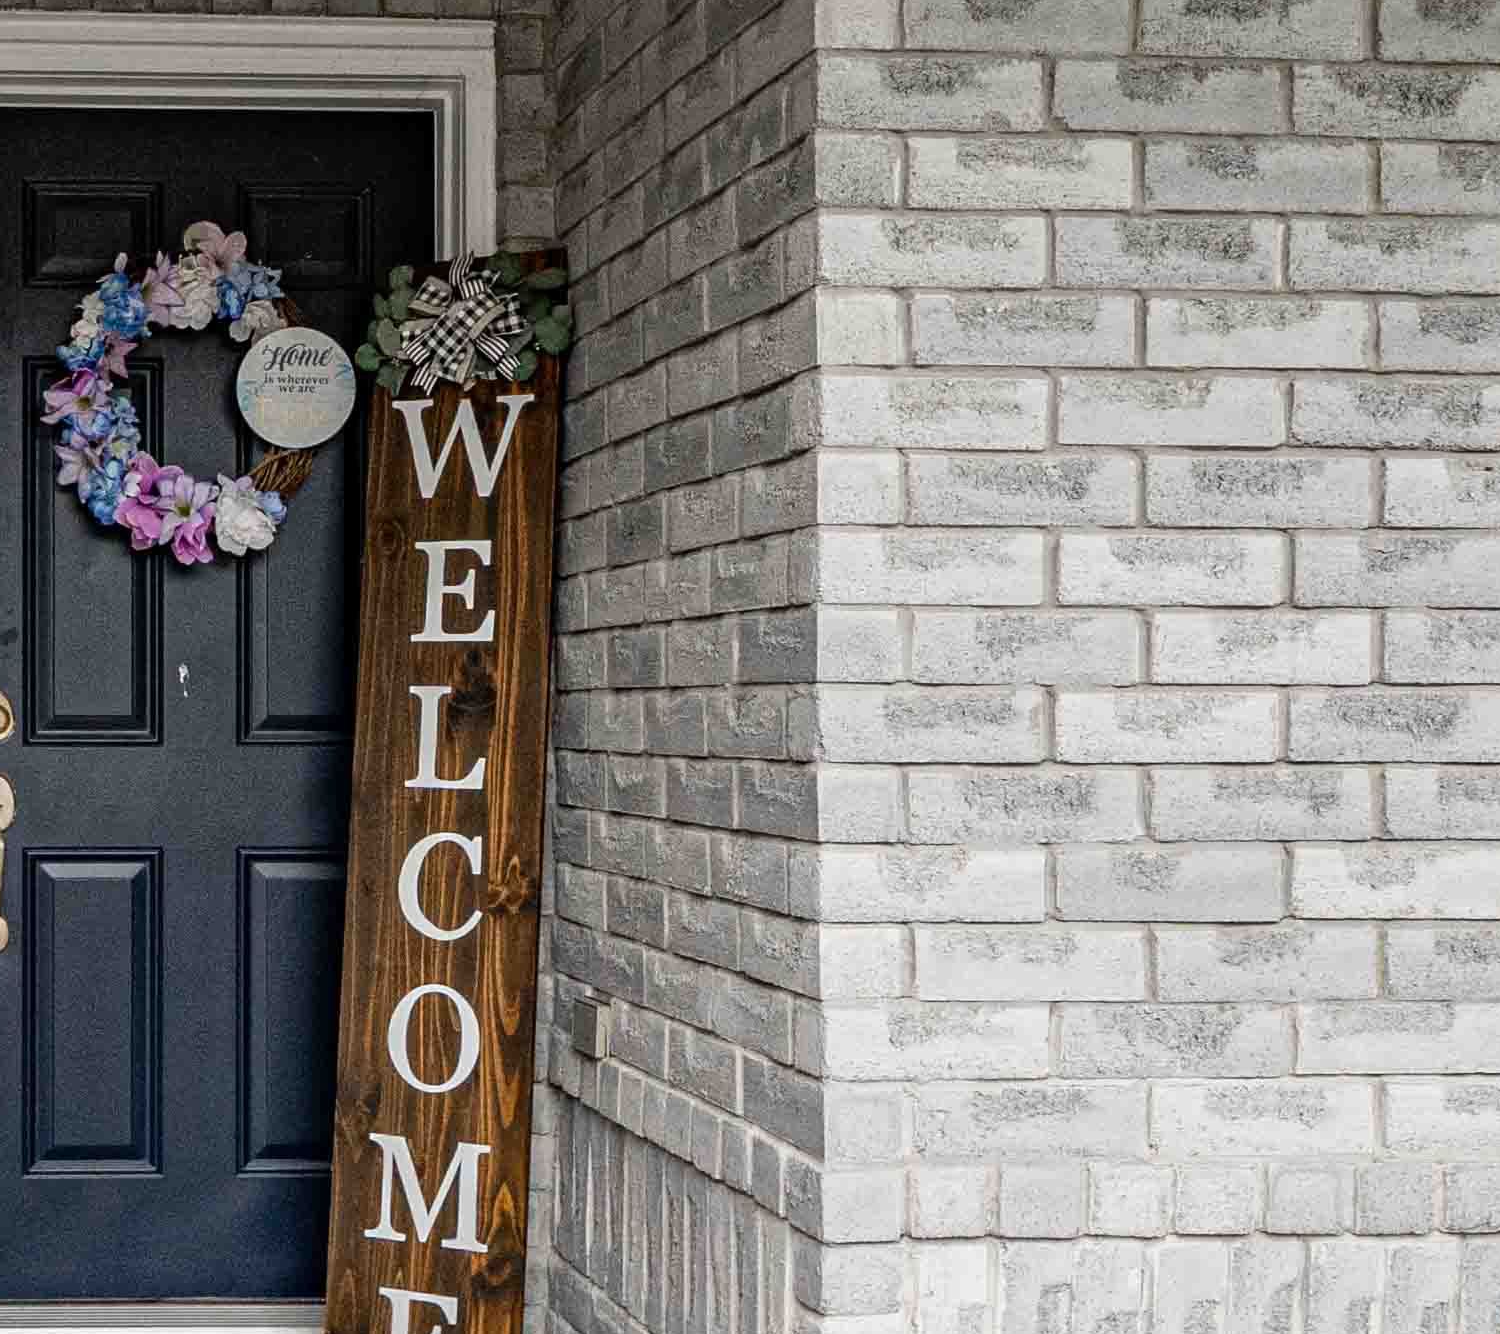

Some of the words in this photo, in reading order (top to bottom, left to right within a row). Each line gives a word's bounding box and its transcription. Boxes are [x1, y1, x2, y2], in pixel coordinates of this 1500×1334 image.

[262, 343, 334, 372] Home
[278, 373, 329, 385] wherever
[279, 385, 295, 394] we
[297, 385, 316, 394] are
